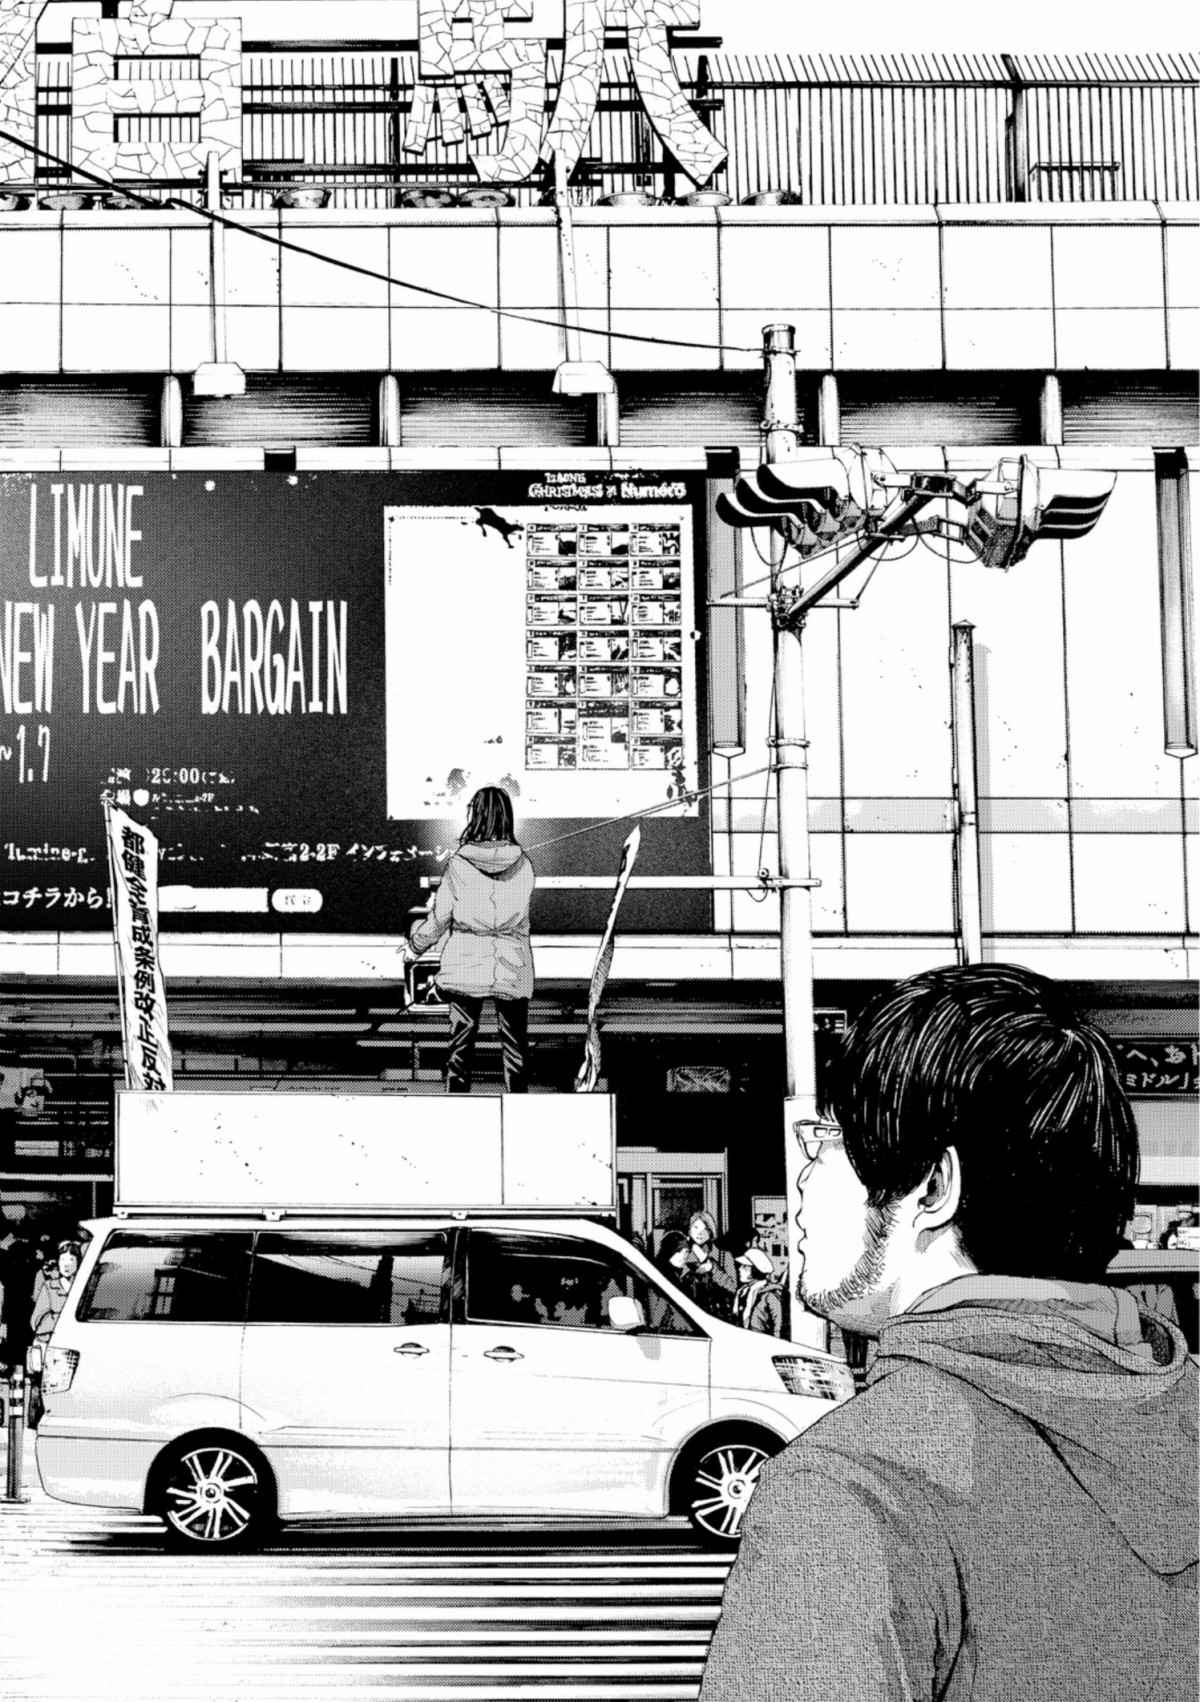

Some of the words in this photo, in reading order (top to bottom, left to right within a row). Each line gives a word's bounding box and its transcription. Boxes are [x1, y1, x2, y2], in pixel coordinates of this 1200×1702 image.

[29, 483, 144, 589] LIMUNE
[75, 598, 160, 714] YEAR
[200, 598, 348, 715] BARGAIN
